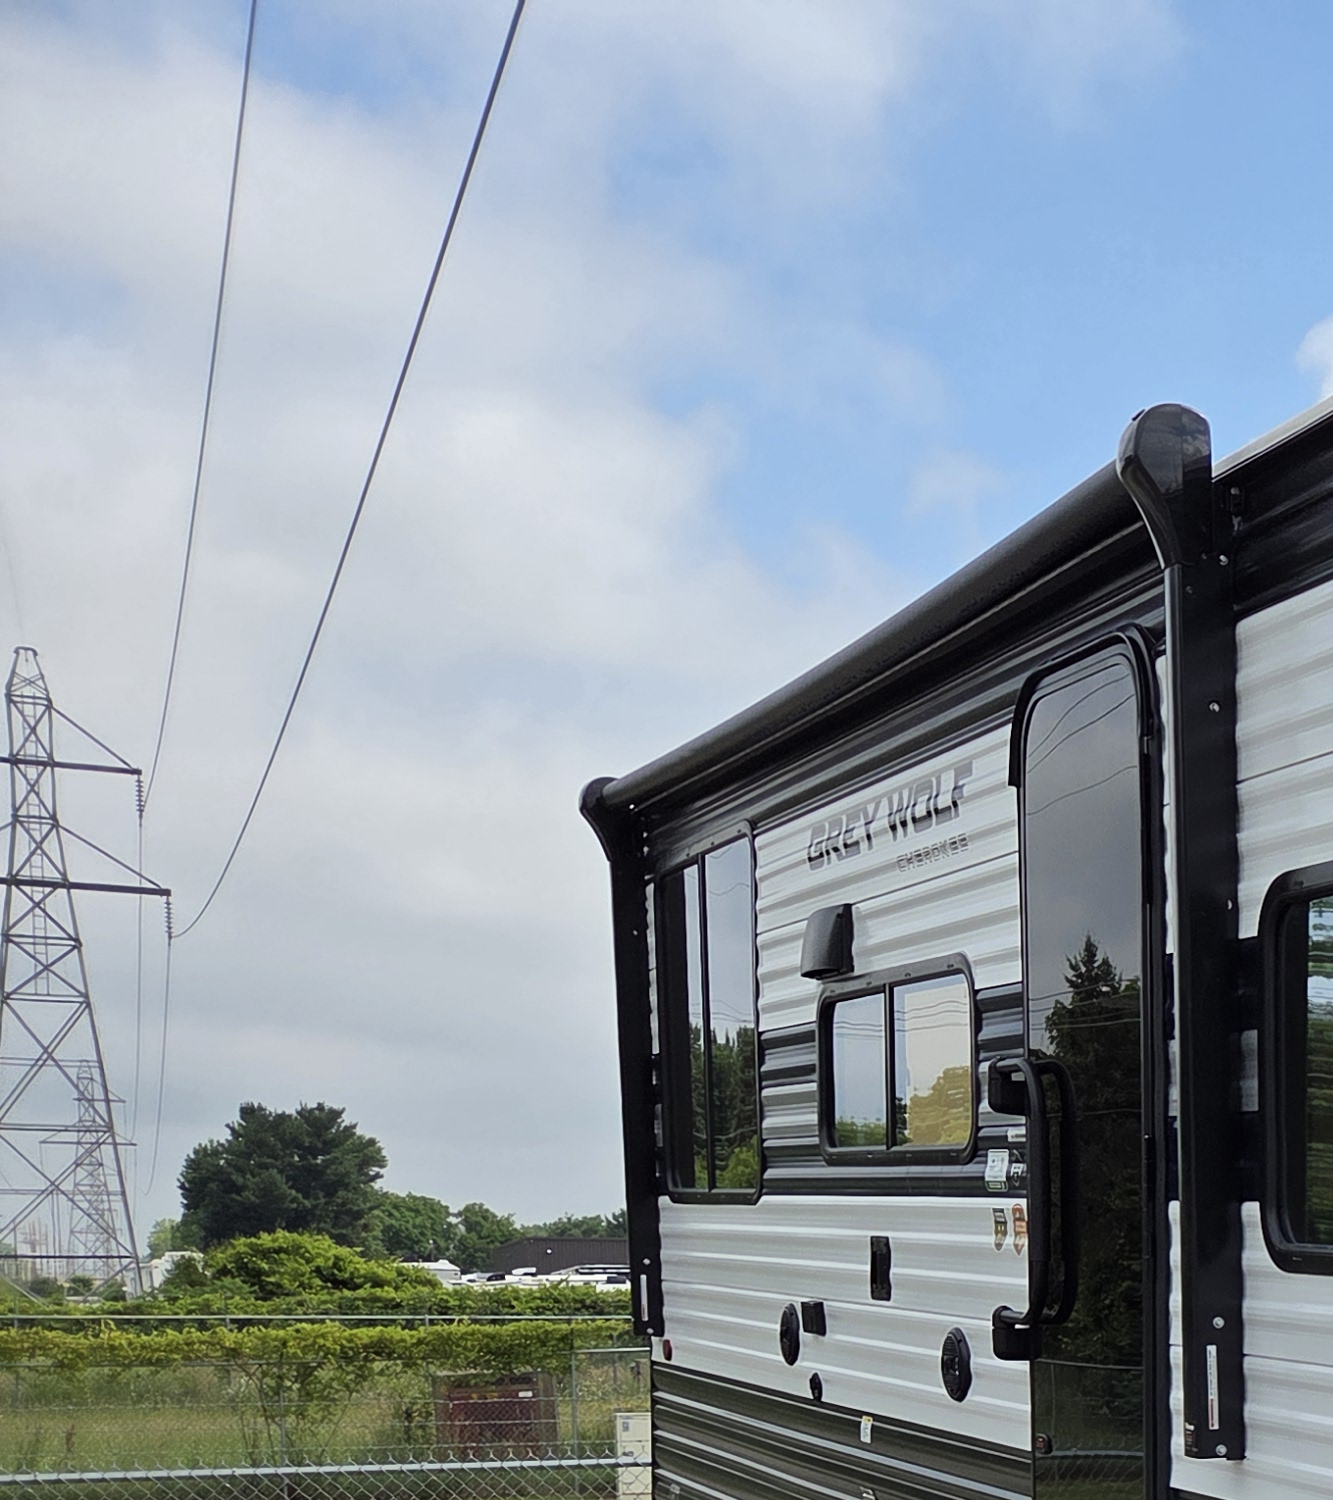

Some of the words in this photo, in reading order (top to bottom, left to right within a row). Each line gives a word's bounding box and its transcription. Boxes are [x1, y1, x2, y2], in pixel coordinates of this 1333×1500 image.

[806, 797, 883, 871] GREY
[884, 760, 973, 843] WOLF
[896, 833, 969, 872] CHEROKEE
